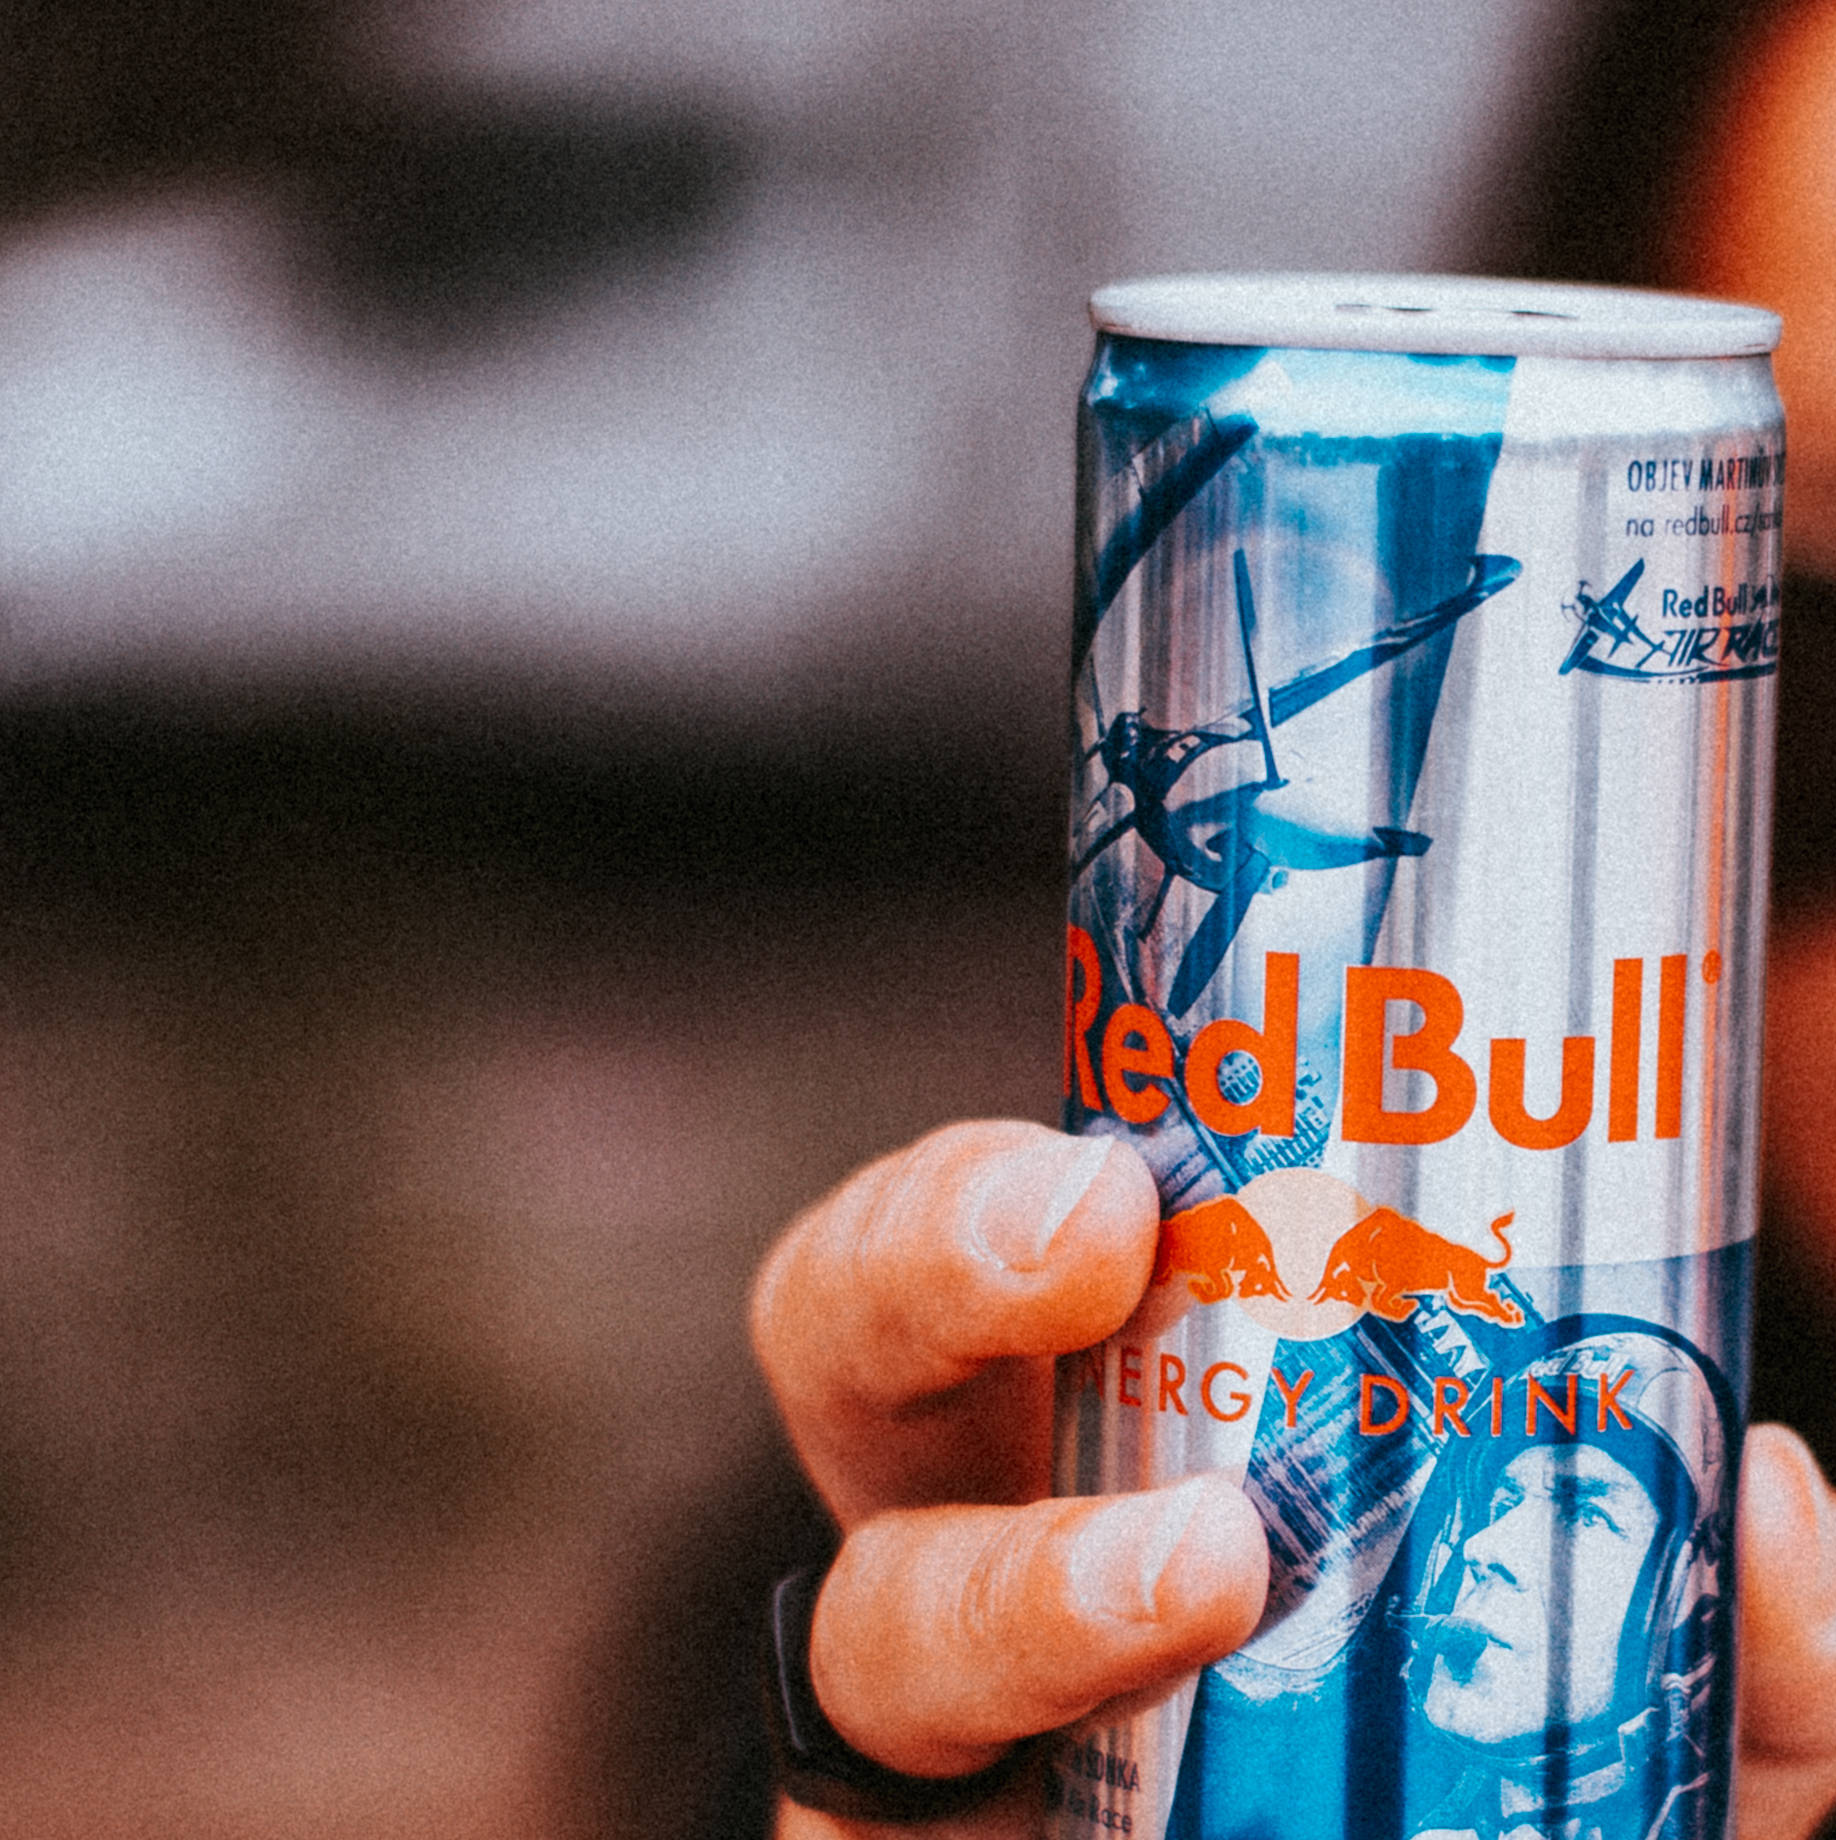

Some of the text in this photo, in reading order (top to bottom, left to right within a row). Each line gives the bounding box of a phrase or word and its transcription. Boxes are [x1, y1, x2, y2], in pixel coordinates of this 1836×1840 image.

[1627, 459, 1694, 492] OBJEV
[1626, 518, 1655, 537] na
[1662, 582, 1748, 618] Red Bull
[1063, 922, 1688, 1151] Red Bull
[1080, 1340, 1636, 1438] NERGY DRINK
